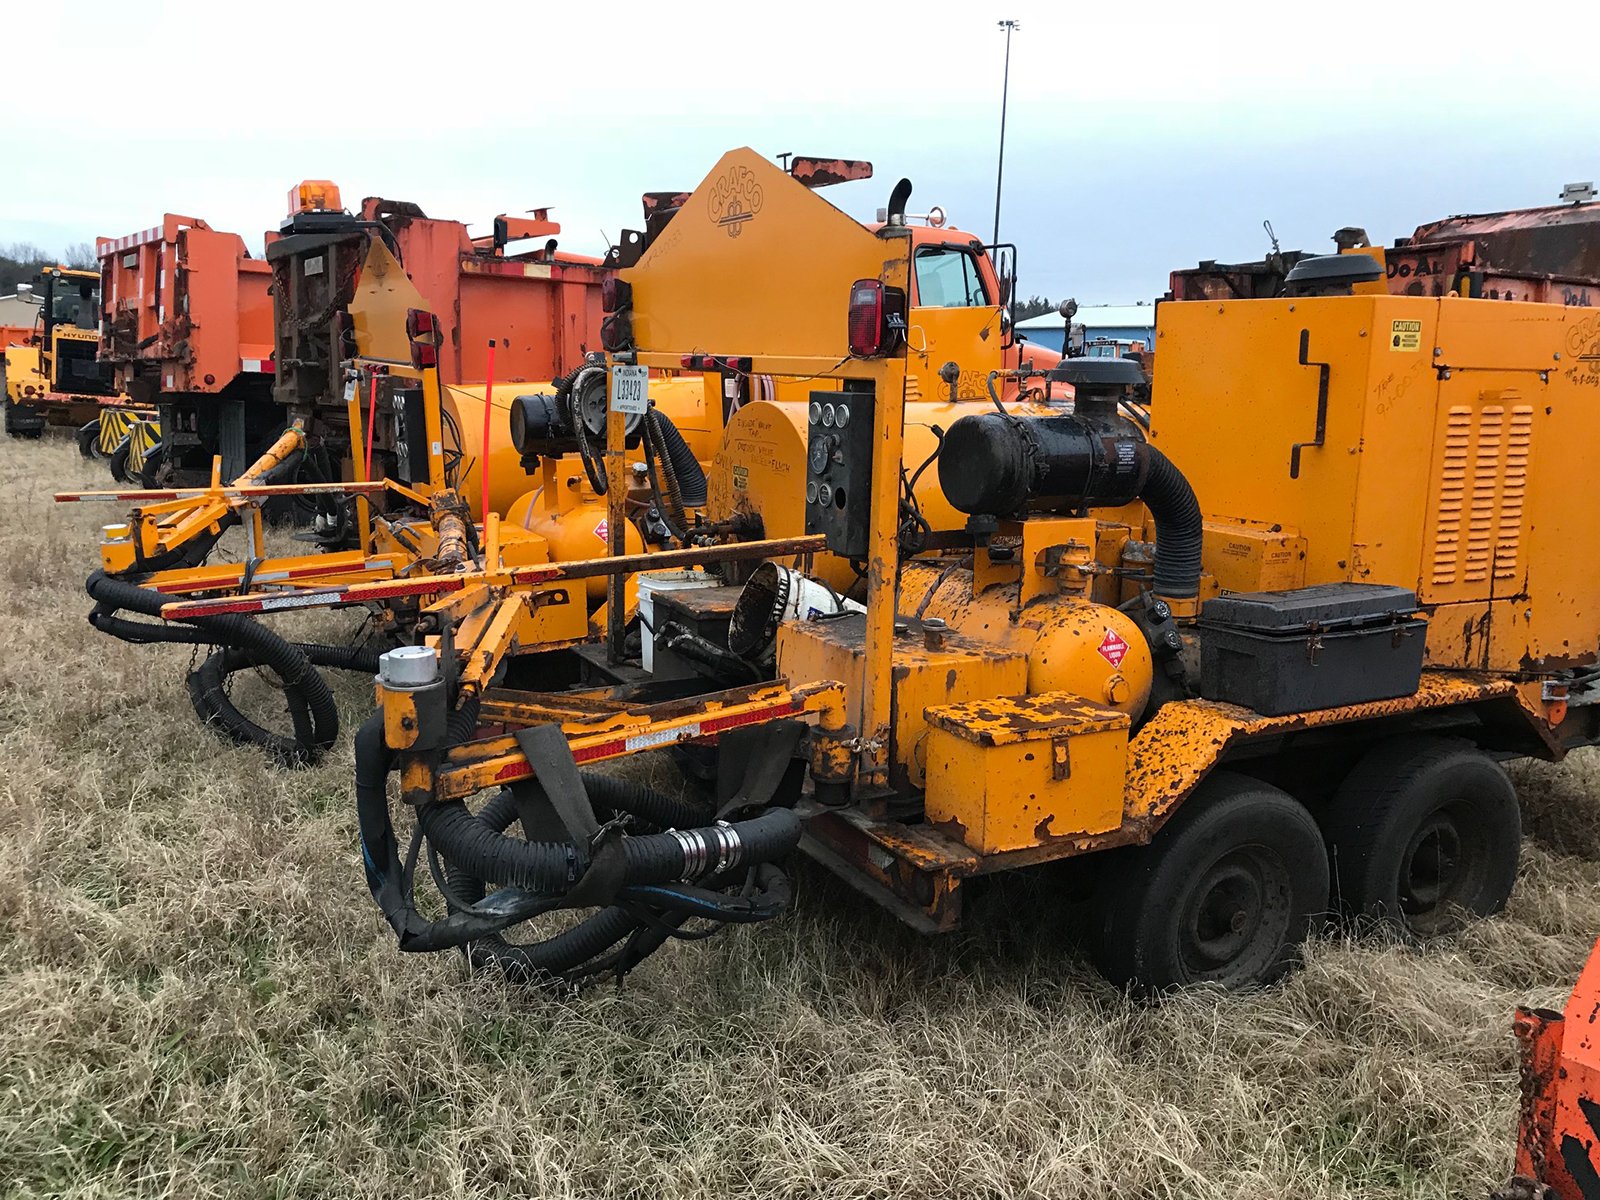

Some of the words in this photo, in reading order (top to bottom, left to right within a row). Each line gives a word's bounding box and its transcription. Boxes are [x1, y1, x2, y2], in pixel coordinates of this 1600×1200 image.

[707, 166, 763, 223] CRAFCO
[1394, 321, 1420, 331] CAUTION
[617, 379, 642, 401] L33423
[1228, 542, 1252, 552] CAUTION
[1270, 551, 1292, 559] CAUTION
[1113, 659, 1119, 667] 3
